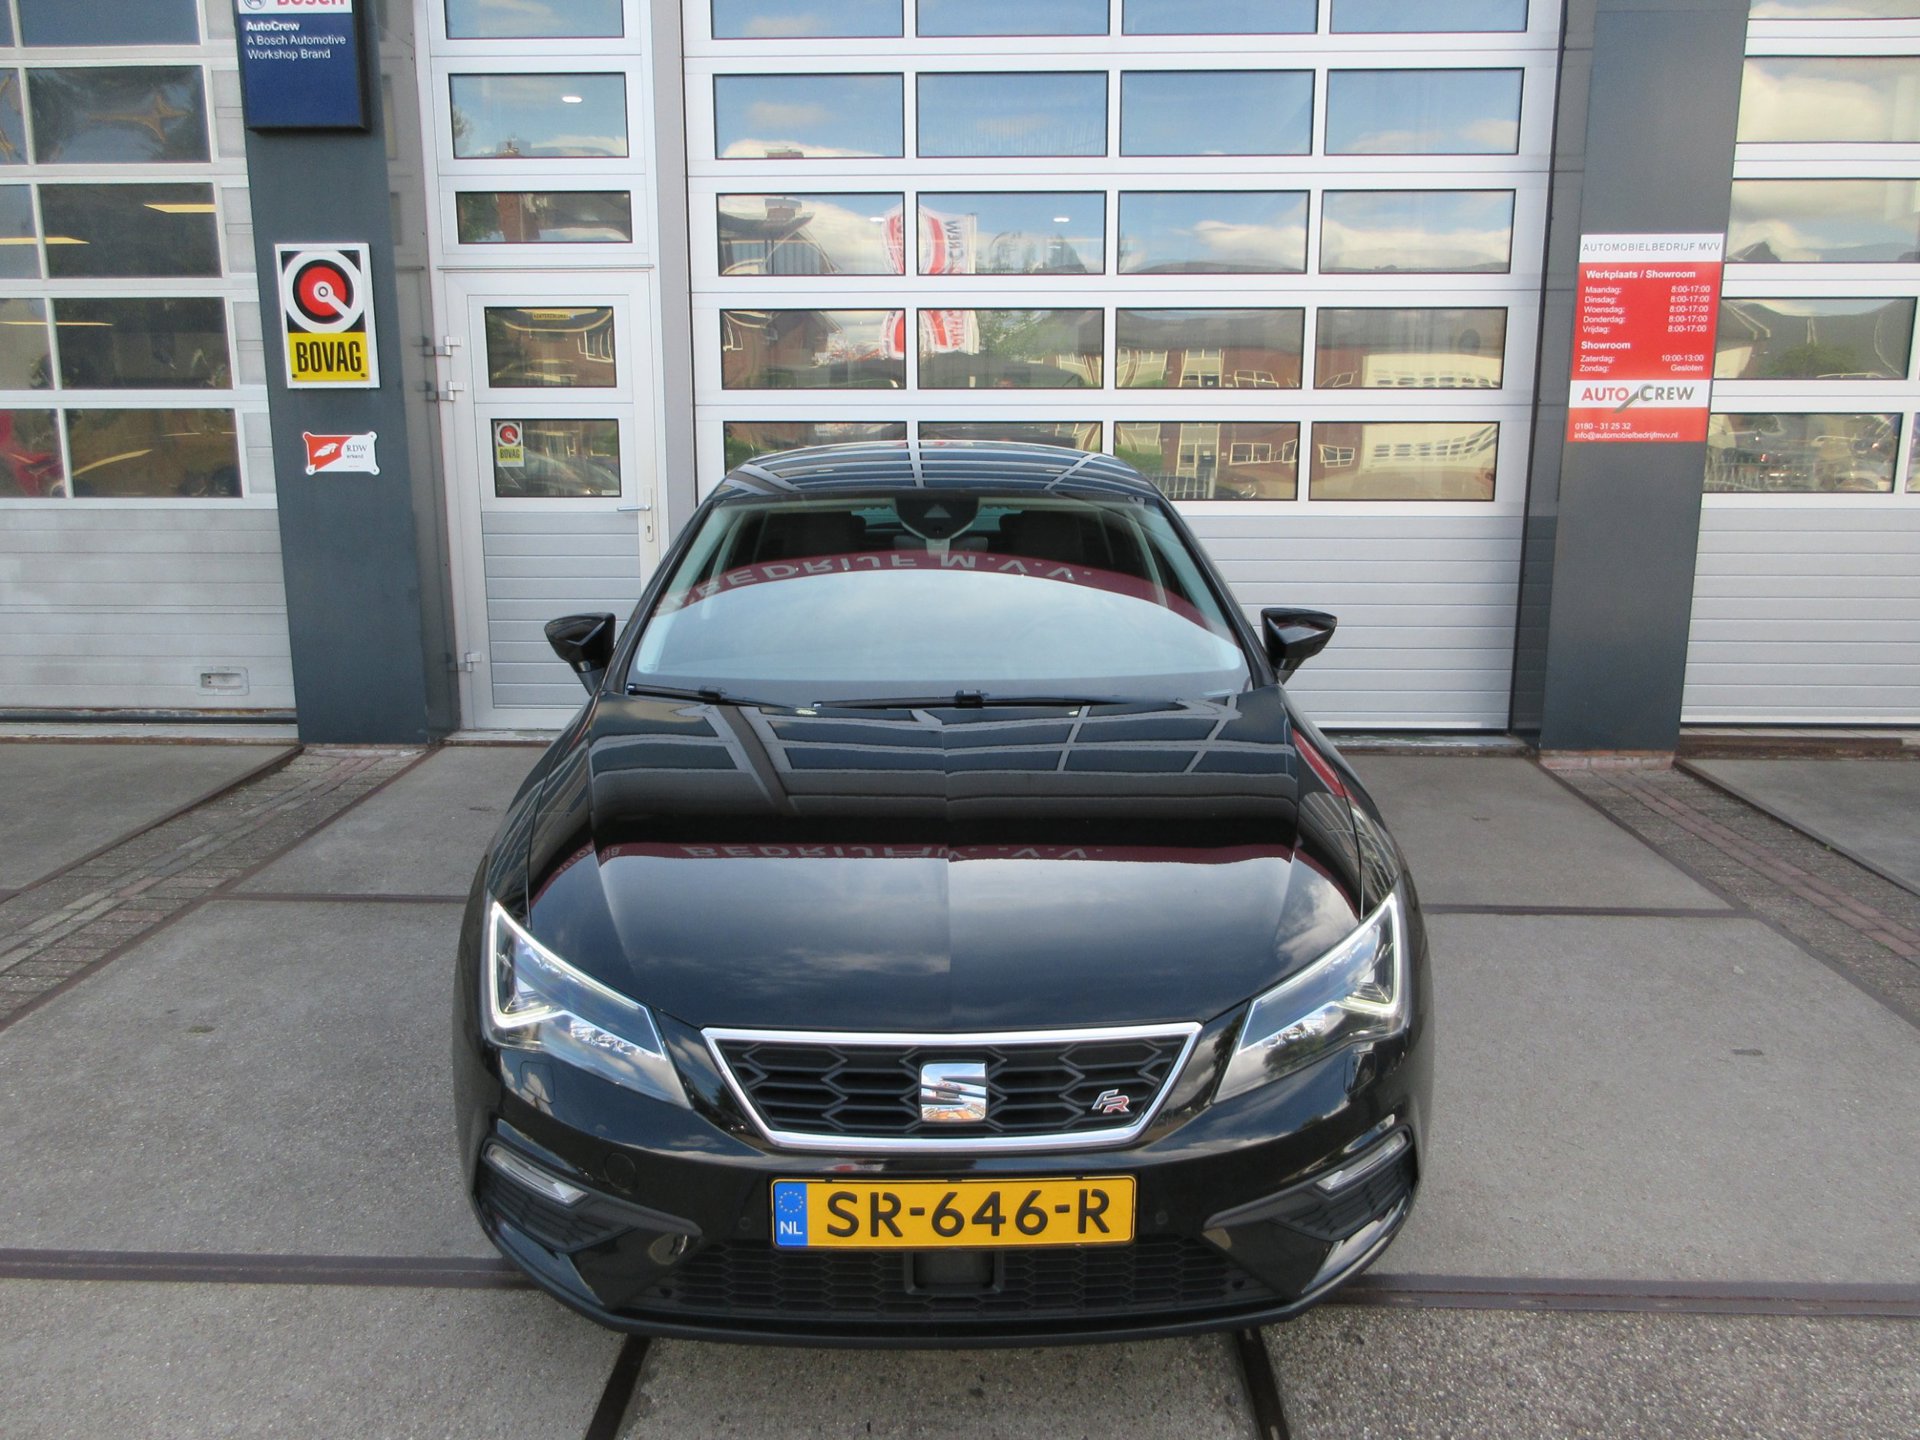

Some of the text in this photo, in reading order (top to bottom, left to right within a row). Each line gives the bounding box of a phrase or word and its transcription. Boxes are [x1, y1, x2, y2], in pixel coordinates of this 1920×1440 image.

[245, 21, 300, 32] AutoCrew
[246, 34, 346, 46] A Bosch Automotive
[248, 49, 331, 61] Workshop Brand
[1583, 242, 1721, 252] AUTOMOBIELBEDRIJF MVV
[1586, 270, 1638, 280] Werkplaats
[1645, 270, 1696, 279] Showroom
[1585, 285, 1711, 295] Maandag: 8:00-17:00
[1584, 295, 1710, 305] Dinsdag: 8:00-17:00
[1584, 305, 1709, 315] Woensdag: 8:00-17:00
[1583, 315, 1708, 325] Donderdag: 8:00-17:00
[1582, 325, 1707, 335] Vrijdag: 8:00-17:00
[1581, 341, 1631, 350] Showroom
[295, 340, 362, 373] BOVAG
[1580, 354, 1704, 364] Zaterdag: 10:00-13:00
[1579, 364, 1704, 374] Zondag: Gesloten
[1581, 384, 1695, 401] AUTO CREW
[1574, 422, 1593, 430] 0180
[1600, 422, 1609, 430] 31
[1611, 422, 1620, 430] 25
[1621, 422, 1631, 430] 32
[499, 448, 520, 459] BOVAG
[1092, 1089, 1130, 1113] FR
[780, 1188, 1110, 1237] NL SR-646-R
